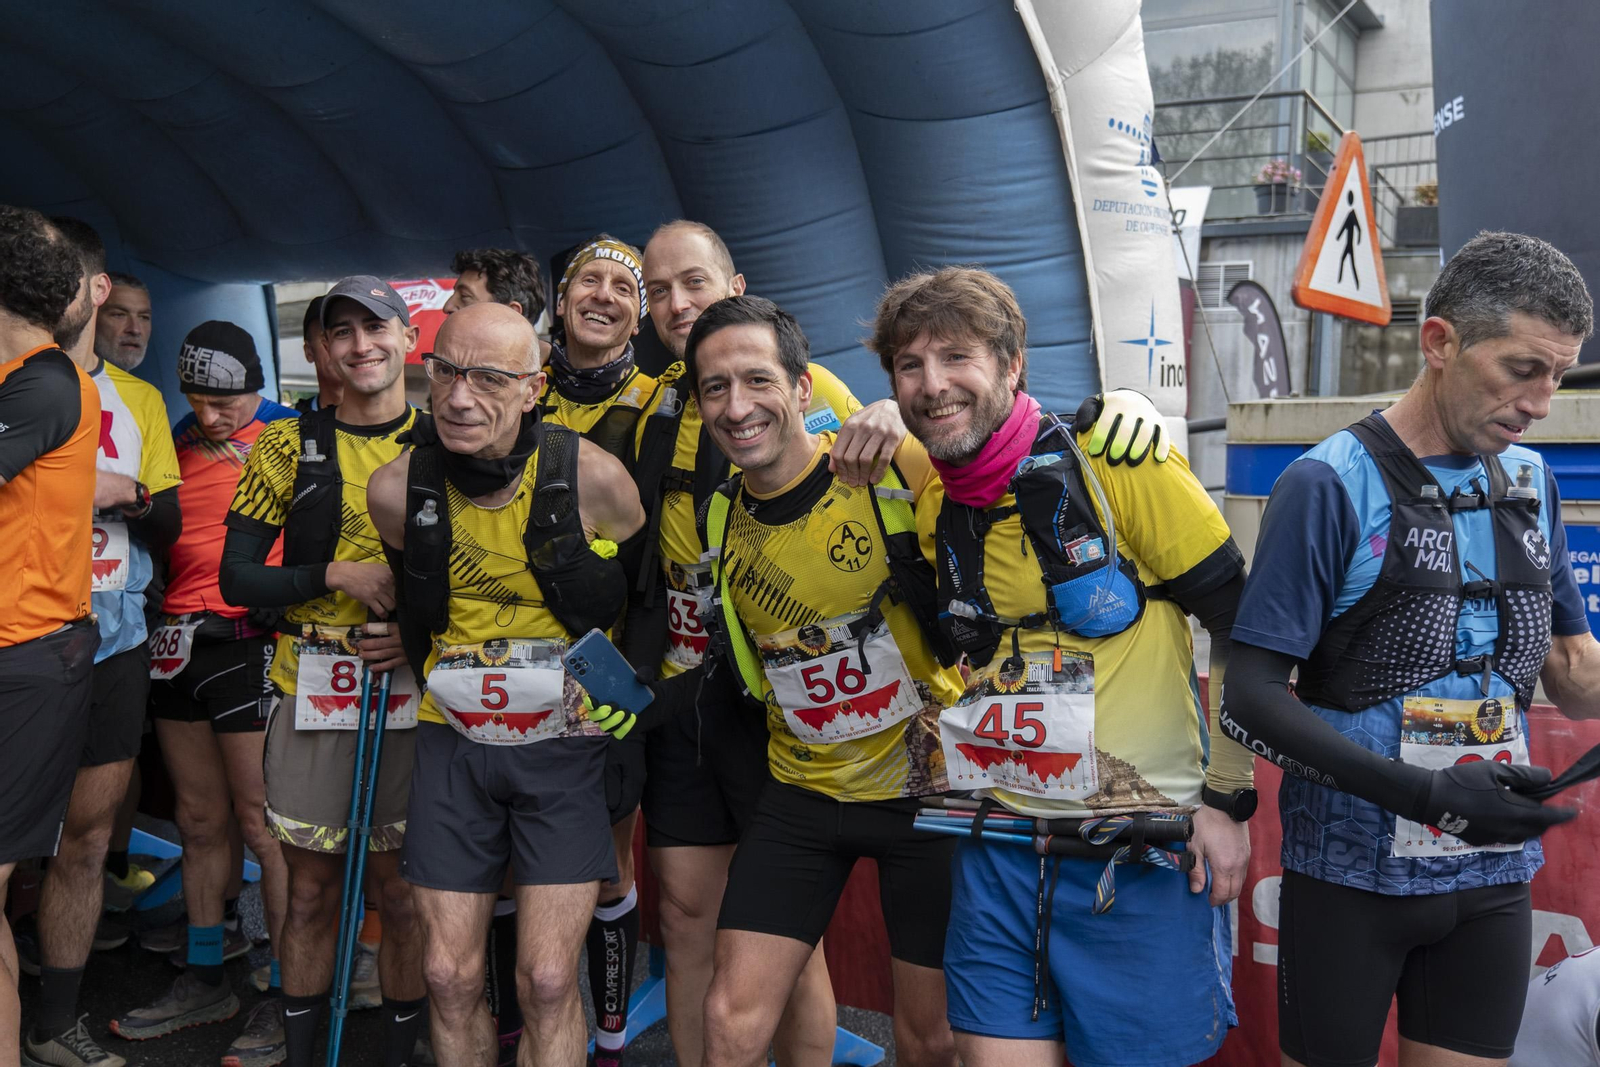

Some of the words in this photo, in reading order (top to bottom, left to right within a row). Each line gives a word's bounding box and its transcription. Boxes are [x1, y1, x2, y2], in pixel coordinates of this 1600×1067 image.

[1125, 220, 1139, 232] DE
[184, 344, 214, 361] THE
[669, 596, 704, 634] 63
[151, 629, 182, 656] 268
[263, 644, 275, 694] WONG
[800, 656, 867, 703] 56
[480, 673, 509, 710] 5
[974, 702, 1047, 748] 45
[603, 929, 620, 1013] COMPRESPORT
